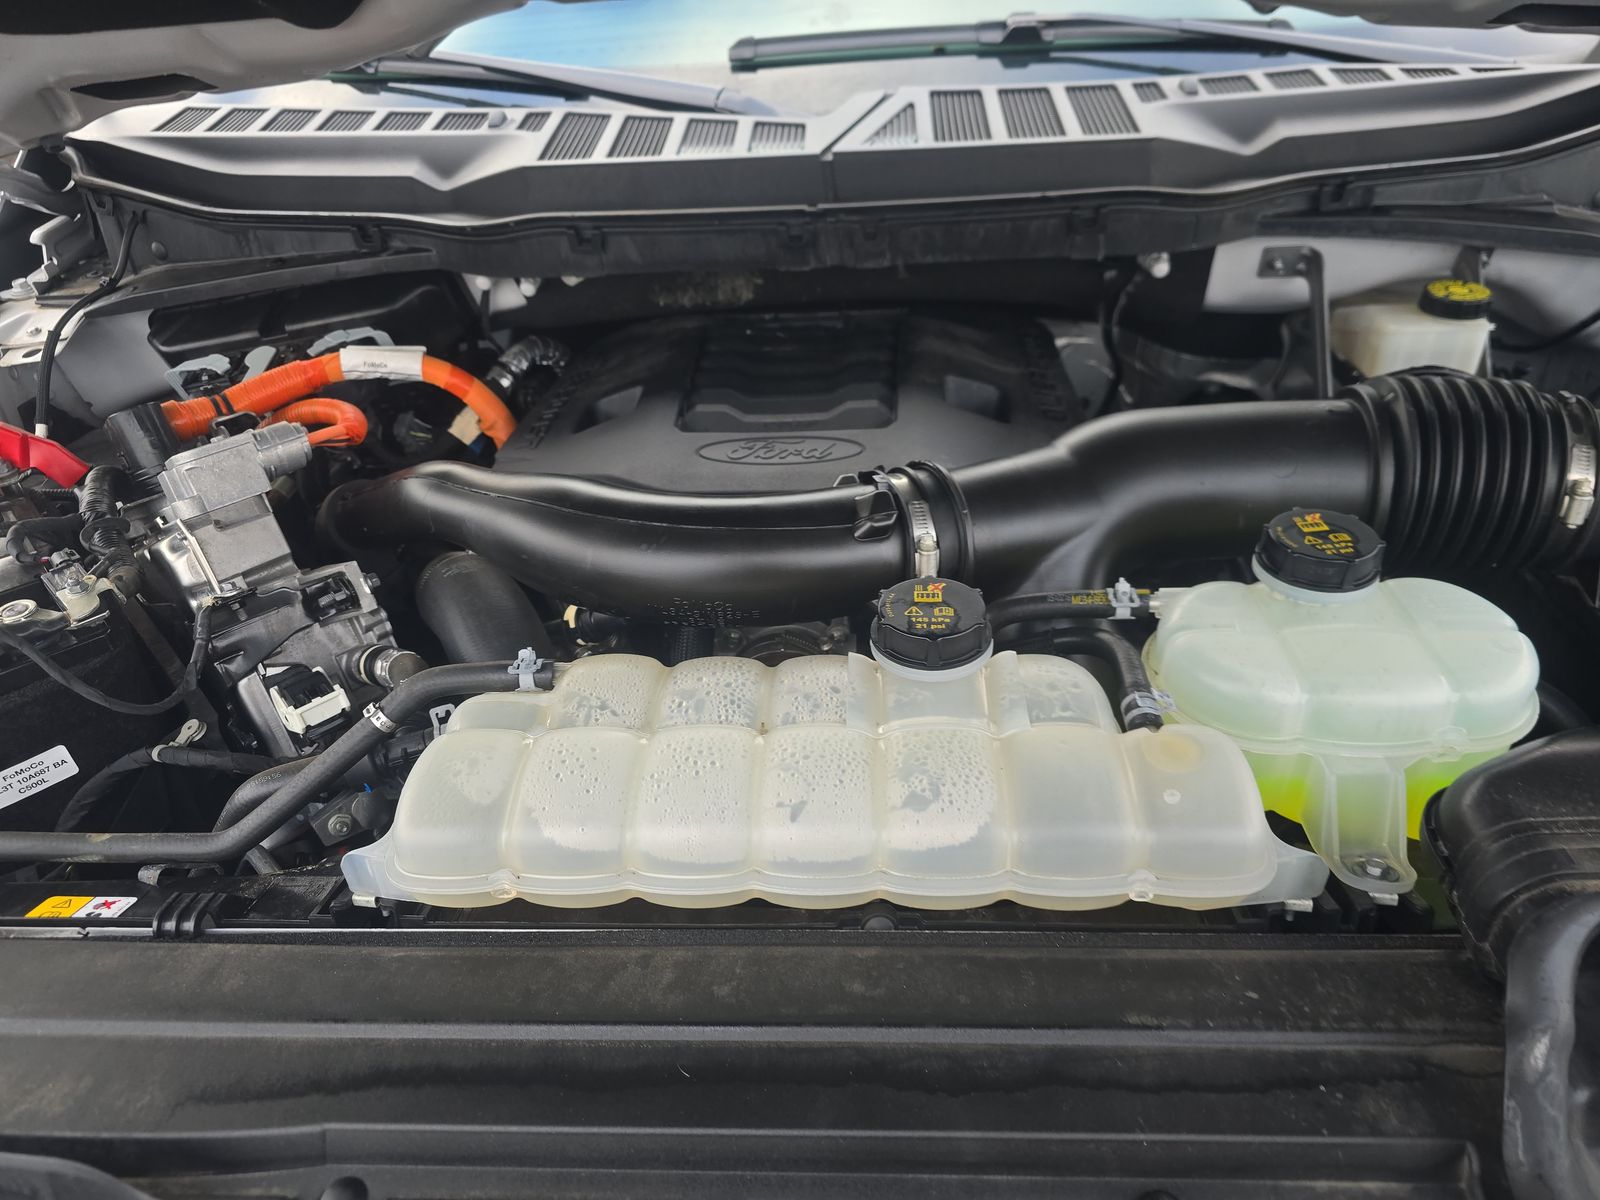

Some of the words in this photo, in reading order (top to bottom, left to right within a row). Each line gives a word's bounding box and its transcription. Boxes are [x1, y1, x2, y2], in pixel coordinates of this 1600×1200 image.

[726, 439, 836, 461] Ford
[2, 760, 44, 782] FoMoCo
[17, 766, 50, 785] 10A687
[52, 759, 69, 769] BA
[18, 778, 50, 794] C500L
